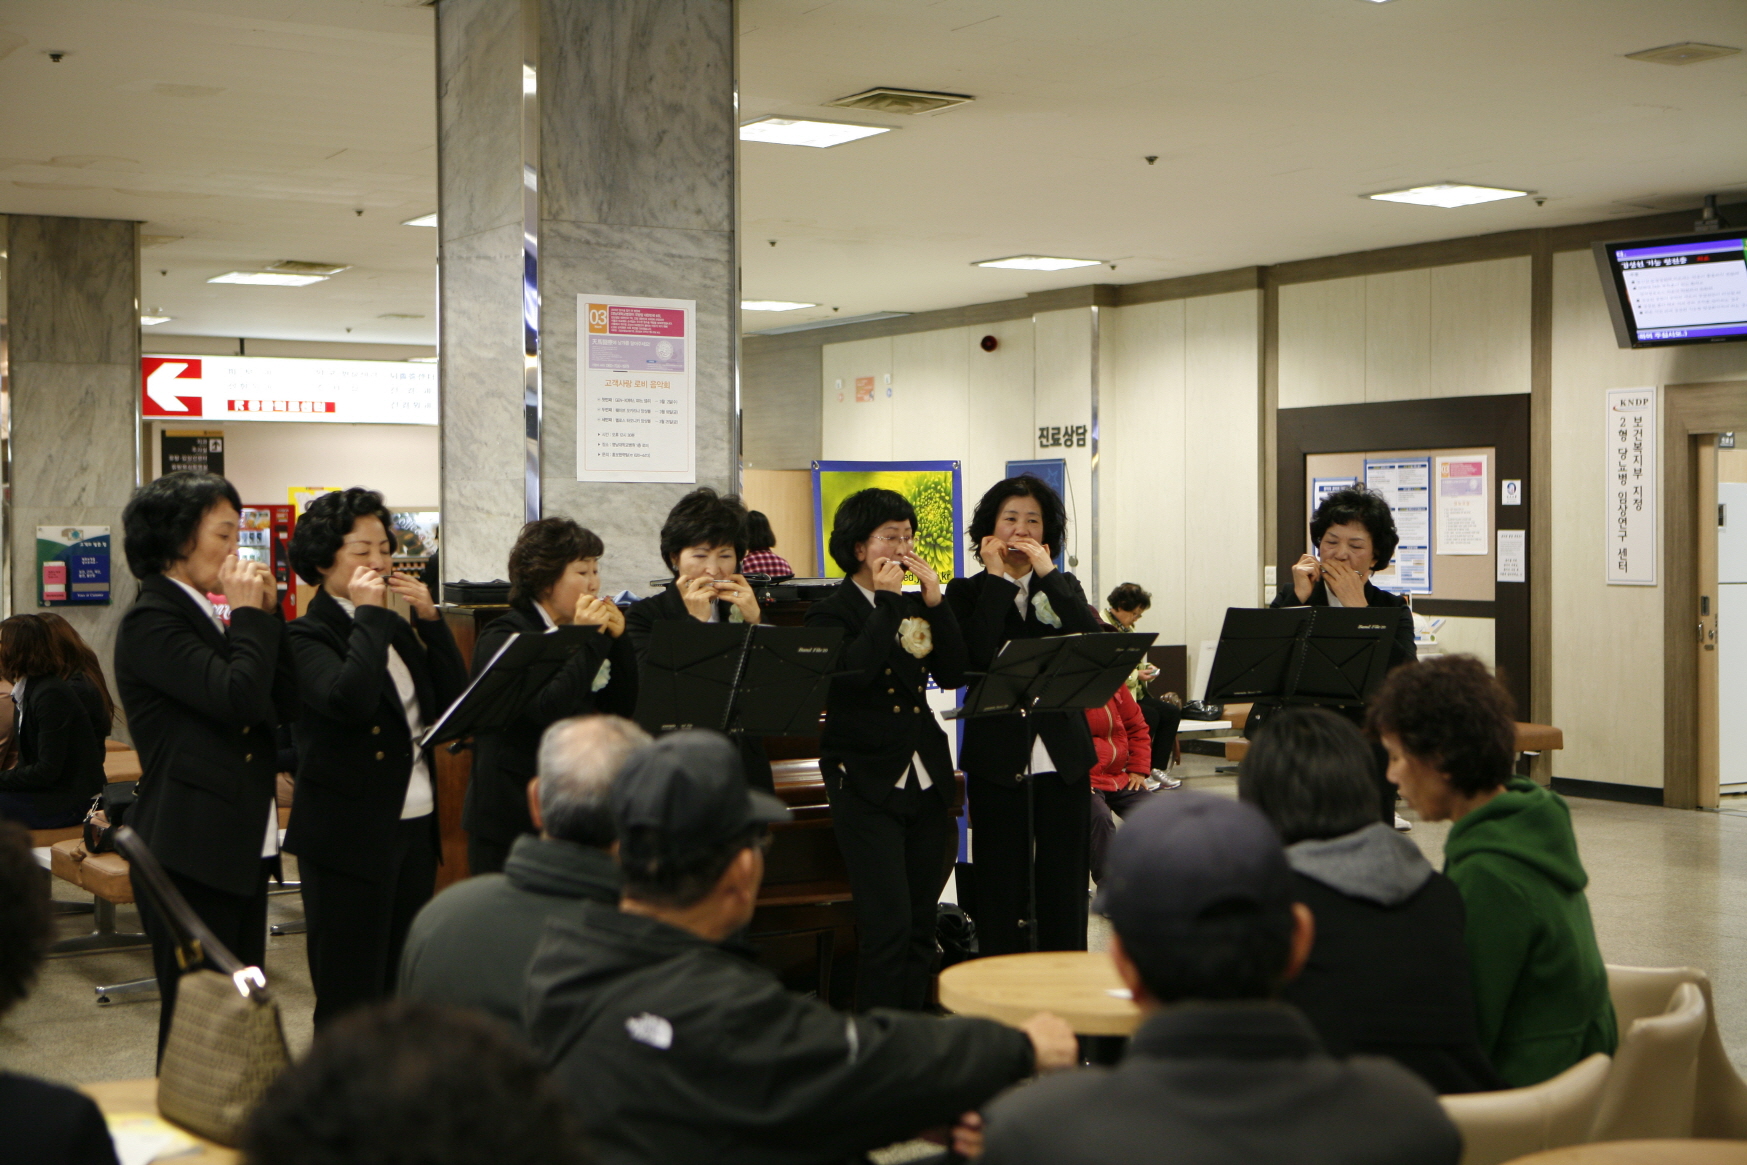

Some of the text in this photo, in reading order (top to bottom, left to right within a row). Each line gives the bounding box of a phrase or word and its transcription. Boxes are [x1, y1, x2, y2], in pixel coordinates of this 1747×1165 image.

[589, 309, 607, 325] 03
[604, 379, 671, 389] 고객사랑 로비 음악회
[1620, 398, 1649, 407] KNDP
[1038, 424, 1088, 448] 진료상담
[1633, 416, 1643, 511] 보건복지부 지정
[1618, 417, 1628, 573] 2형 당뇨병 임상연구 센터
